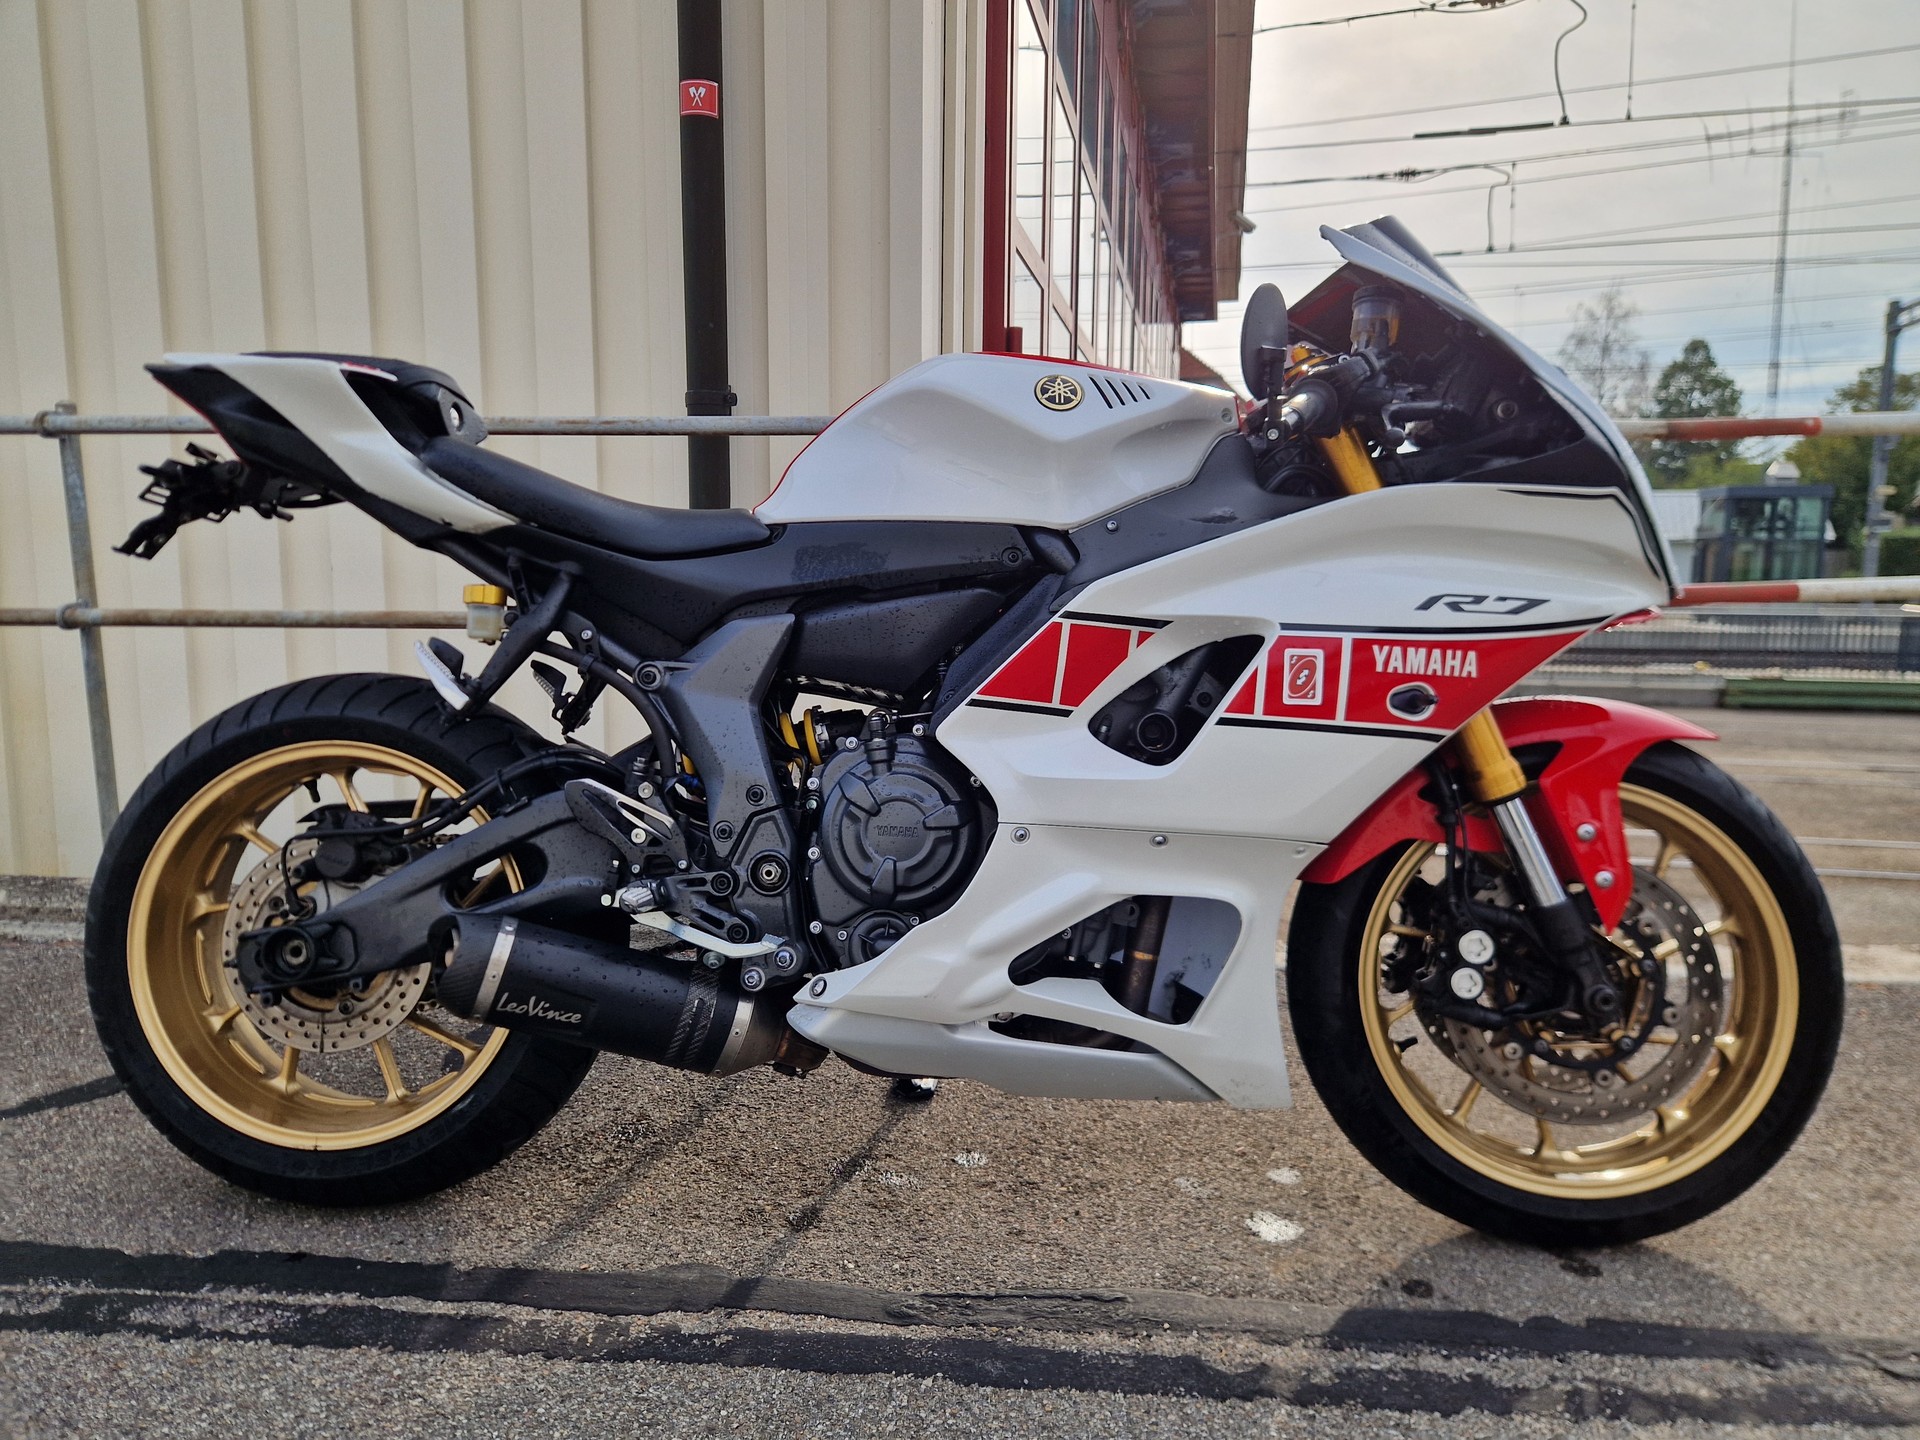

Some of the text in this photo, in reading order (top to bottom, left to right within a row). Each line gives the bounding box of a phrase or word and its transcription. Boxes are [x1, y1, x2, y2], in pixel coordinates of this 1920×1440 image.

[1414, 593, 1551, 615] R7
[1372, 644, 1478, 678] YAMAHA
[876, 824, 920, 838] YAMAHA
[496, 991, 582, 1023] LeoVince
